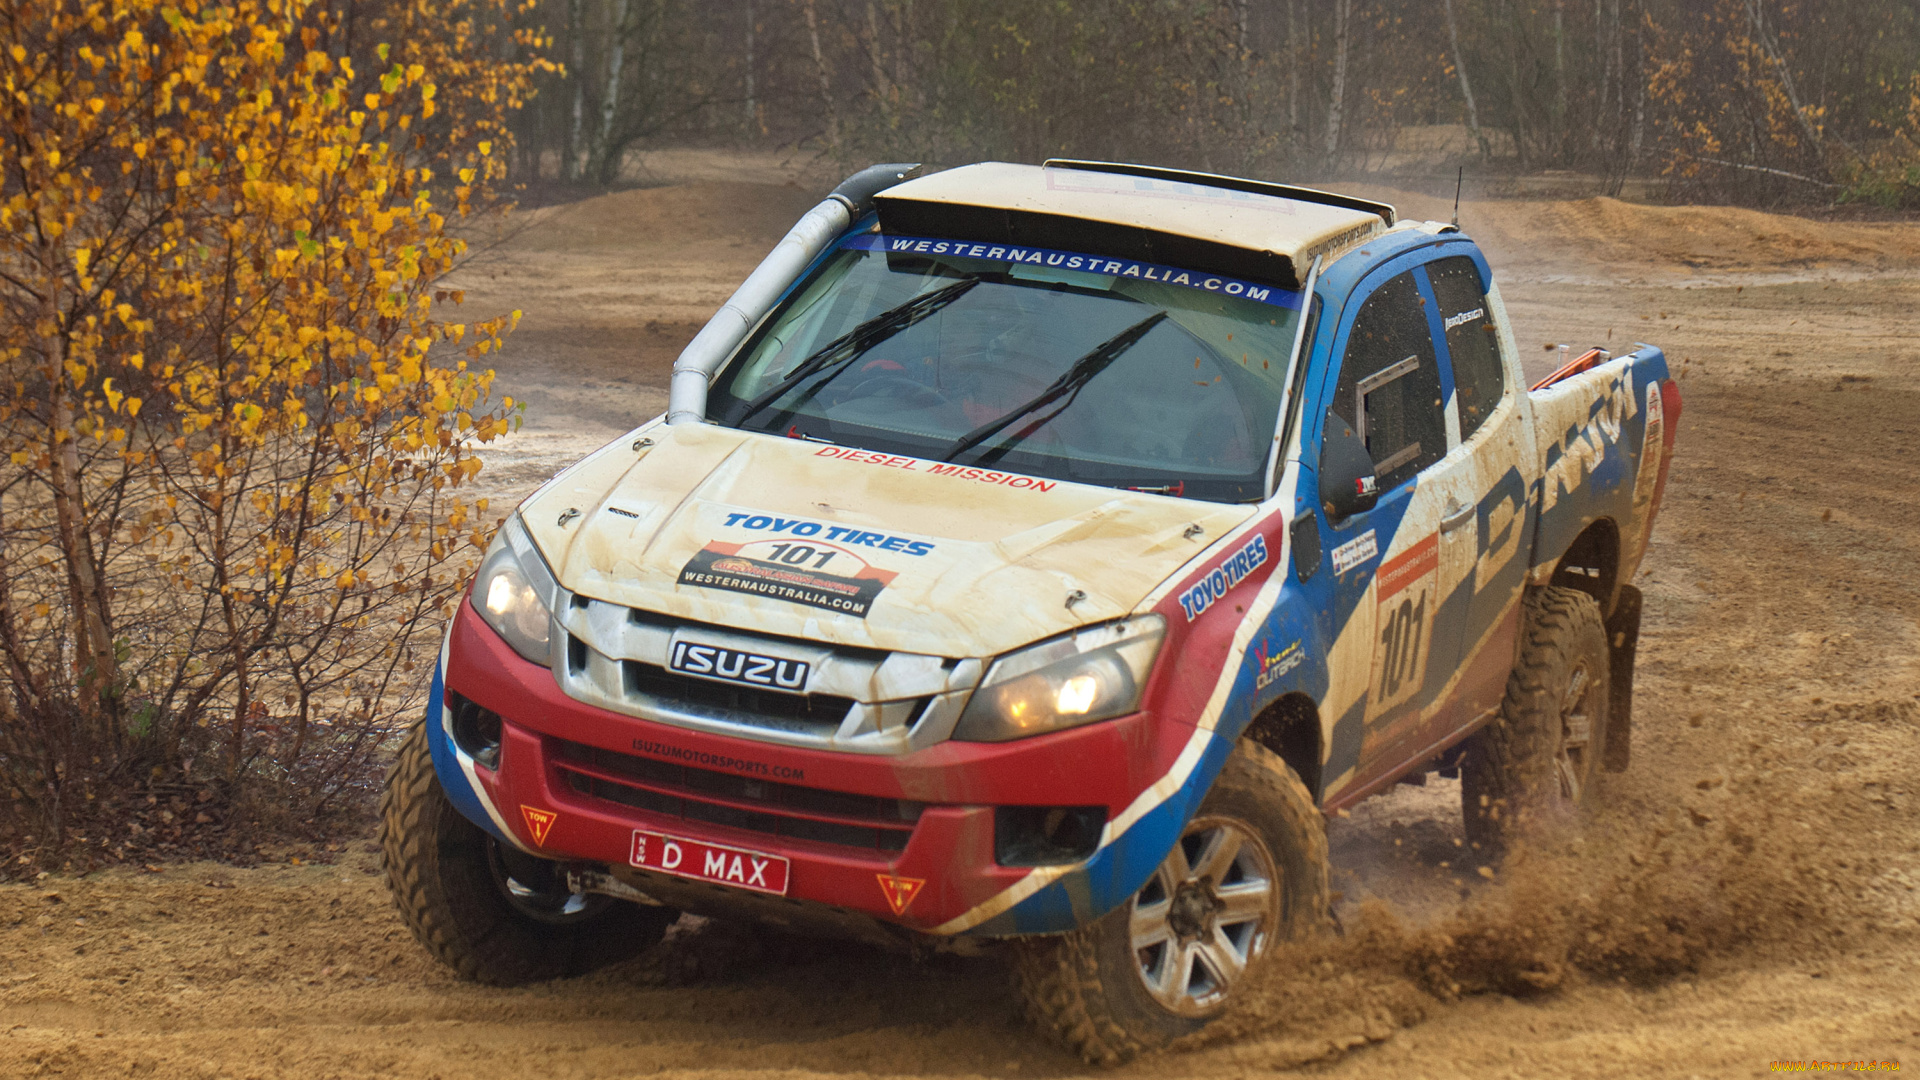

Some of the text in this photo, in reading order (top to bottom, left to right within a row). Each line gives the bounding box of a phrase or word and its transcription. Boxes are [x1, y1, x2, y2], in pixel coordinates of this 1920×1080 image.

[892, 239, 1270, 301] WESTERNAUSTRALIA.COM
[814, 446, 1056, 493] DIESEL MISSION
[723, 513, 936, 557] TOYO TIRES
[767, 543, 837, 569] 101
[684, 571, 865, 614] WESTERNAUSTRALIA.COM
[1178, 532, 1268, 622] TOYO TIRES
[673, 643, 807, 688] ISUZU
[1378, 588, 1426, 703] 101
[632, 738, 805, 780] ISUZUMOTORSPORTS.COM
[528, 811, 548, 823] TOW
[662, 842, 769, 887] D MAX
